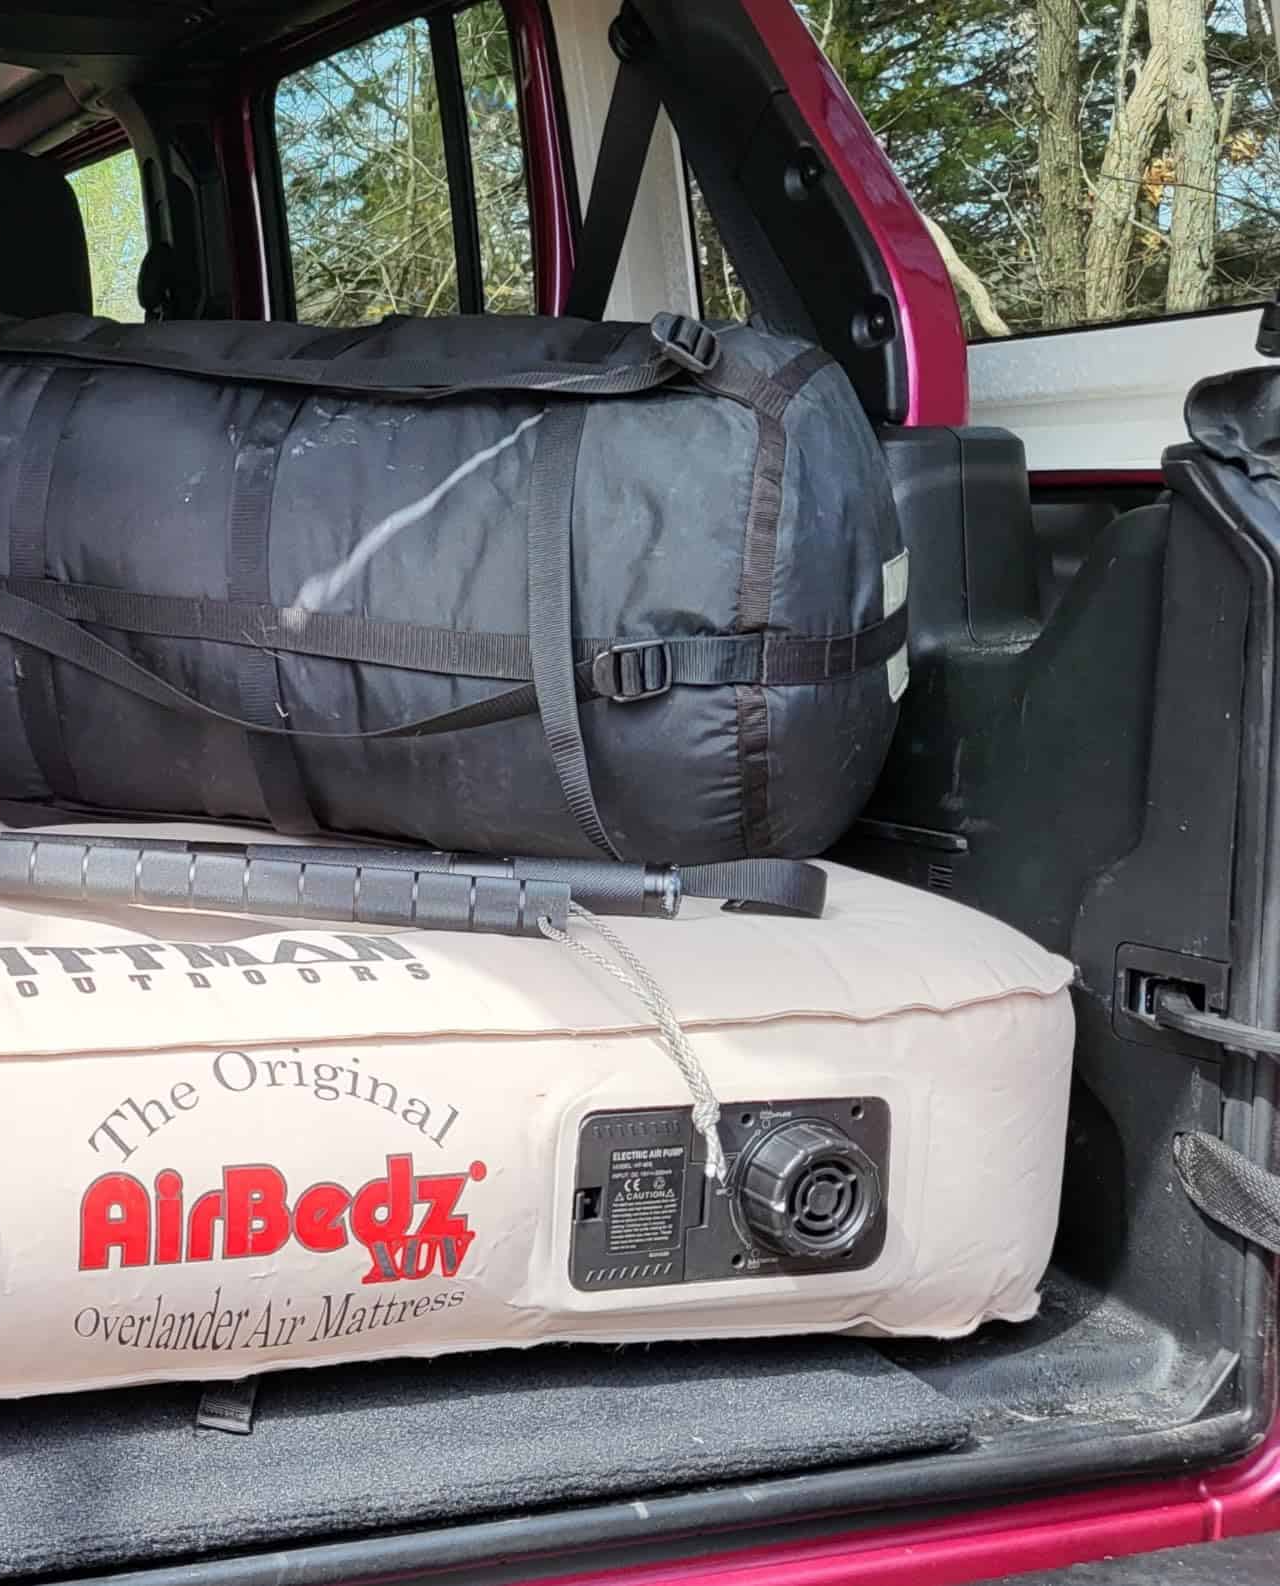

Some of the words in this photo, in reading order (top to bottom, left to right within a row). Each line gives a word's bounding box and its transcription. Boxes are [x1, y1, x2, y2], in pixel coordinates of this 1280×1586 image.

[16, 961, 431, 998] OUTDOORS
[88, 1081, 200, 1163] The
[212, 1047, 460, 1149] Original
[612, 1150, 649, 1161] ELECTRIC
[649, 1148, 662, 1159] AIR
[79, 1153, 472, 1271] AirBedz
[626, 1190, 665, 1201] CAUTION
[361, 1231, 477, 1284] XUV
[74, 1286, 250, 1352] Overlander
[241, 1297, 306, 1348] Air
[308, 1287, 466, 1344] Mattress
